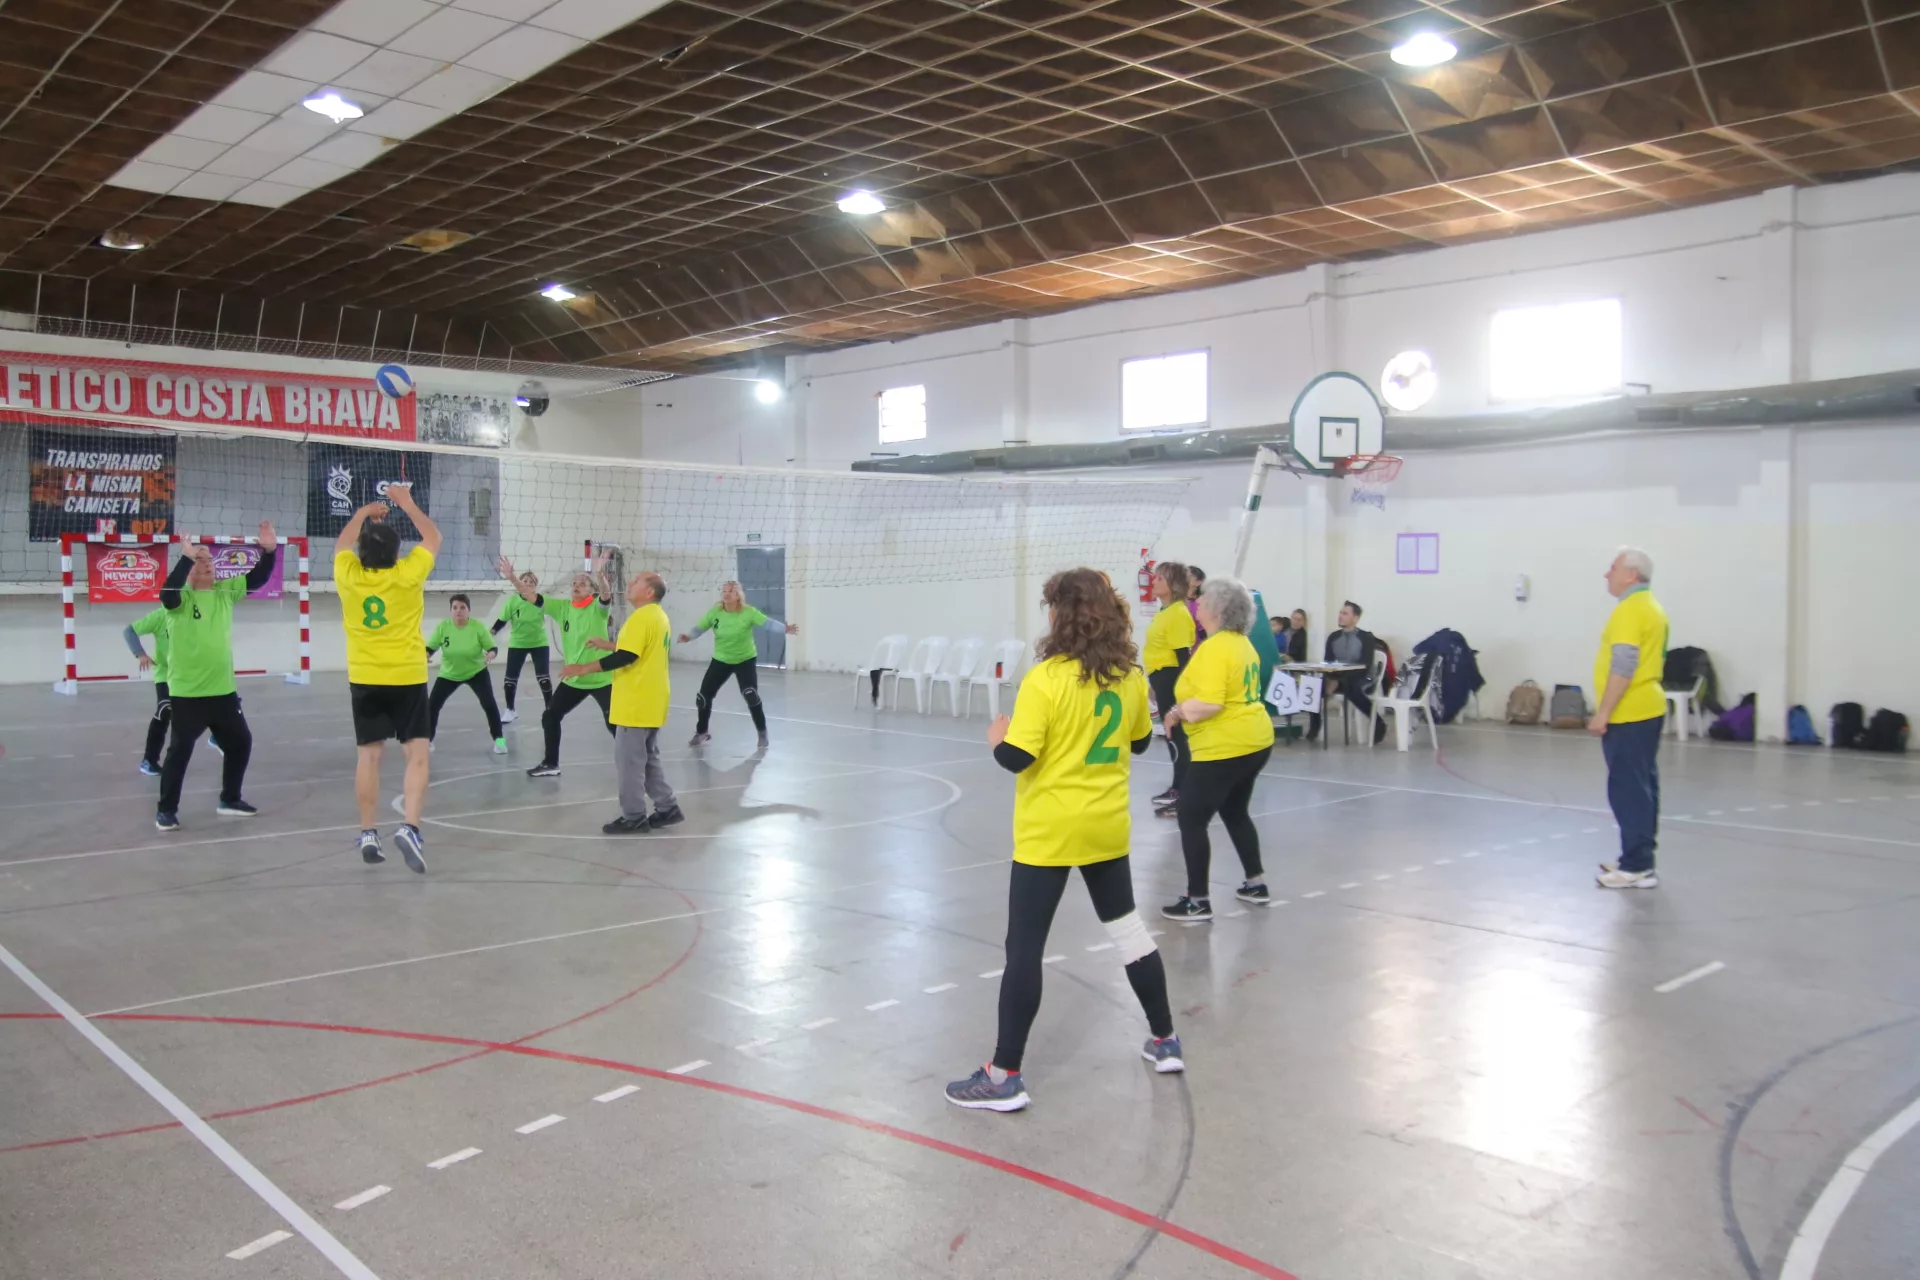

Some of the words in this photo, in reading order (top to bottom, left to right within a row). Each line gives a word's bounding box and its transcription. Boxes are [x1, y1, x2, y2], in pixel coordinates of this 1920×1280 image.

[0, 364, 130, 413] ETICO
[146, 374, 272, 422] COSTA
[285, 384, 401, 429] BRAVA
[47, 449, 163, 471] TRANSPIRAMOS
[64, 473, 87, 491] LA
[91, 475, 142, 493] MISMA
[64, 496, 141, 514] CAMISETA
[331, 500, 349, 509] CAH
[104, 571, 153, 581] NEWCOM
[193, 604, 202, 619] 8
[362, 595, 389, 630] 8
[713, 618, 720, 629] 2
[443, 636, 450, 648] 5
[1273, 683, 1285, 701] 6
[1302, 686, 1313, 706] 3
[1085, 690, 1123, 766] 2
